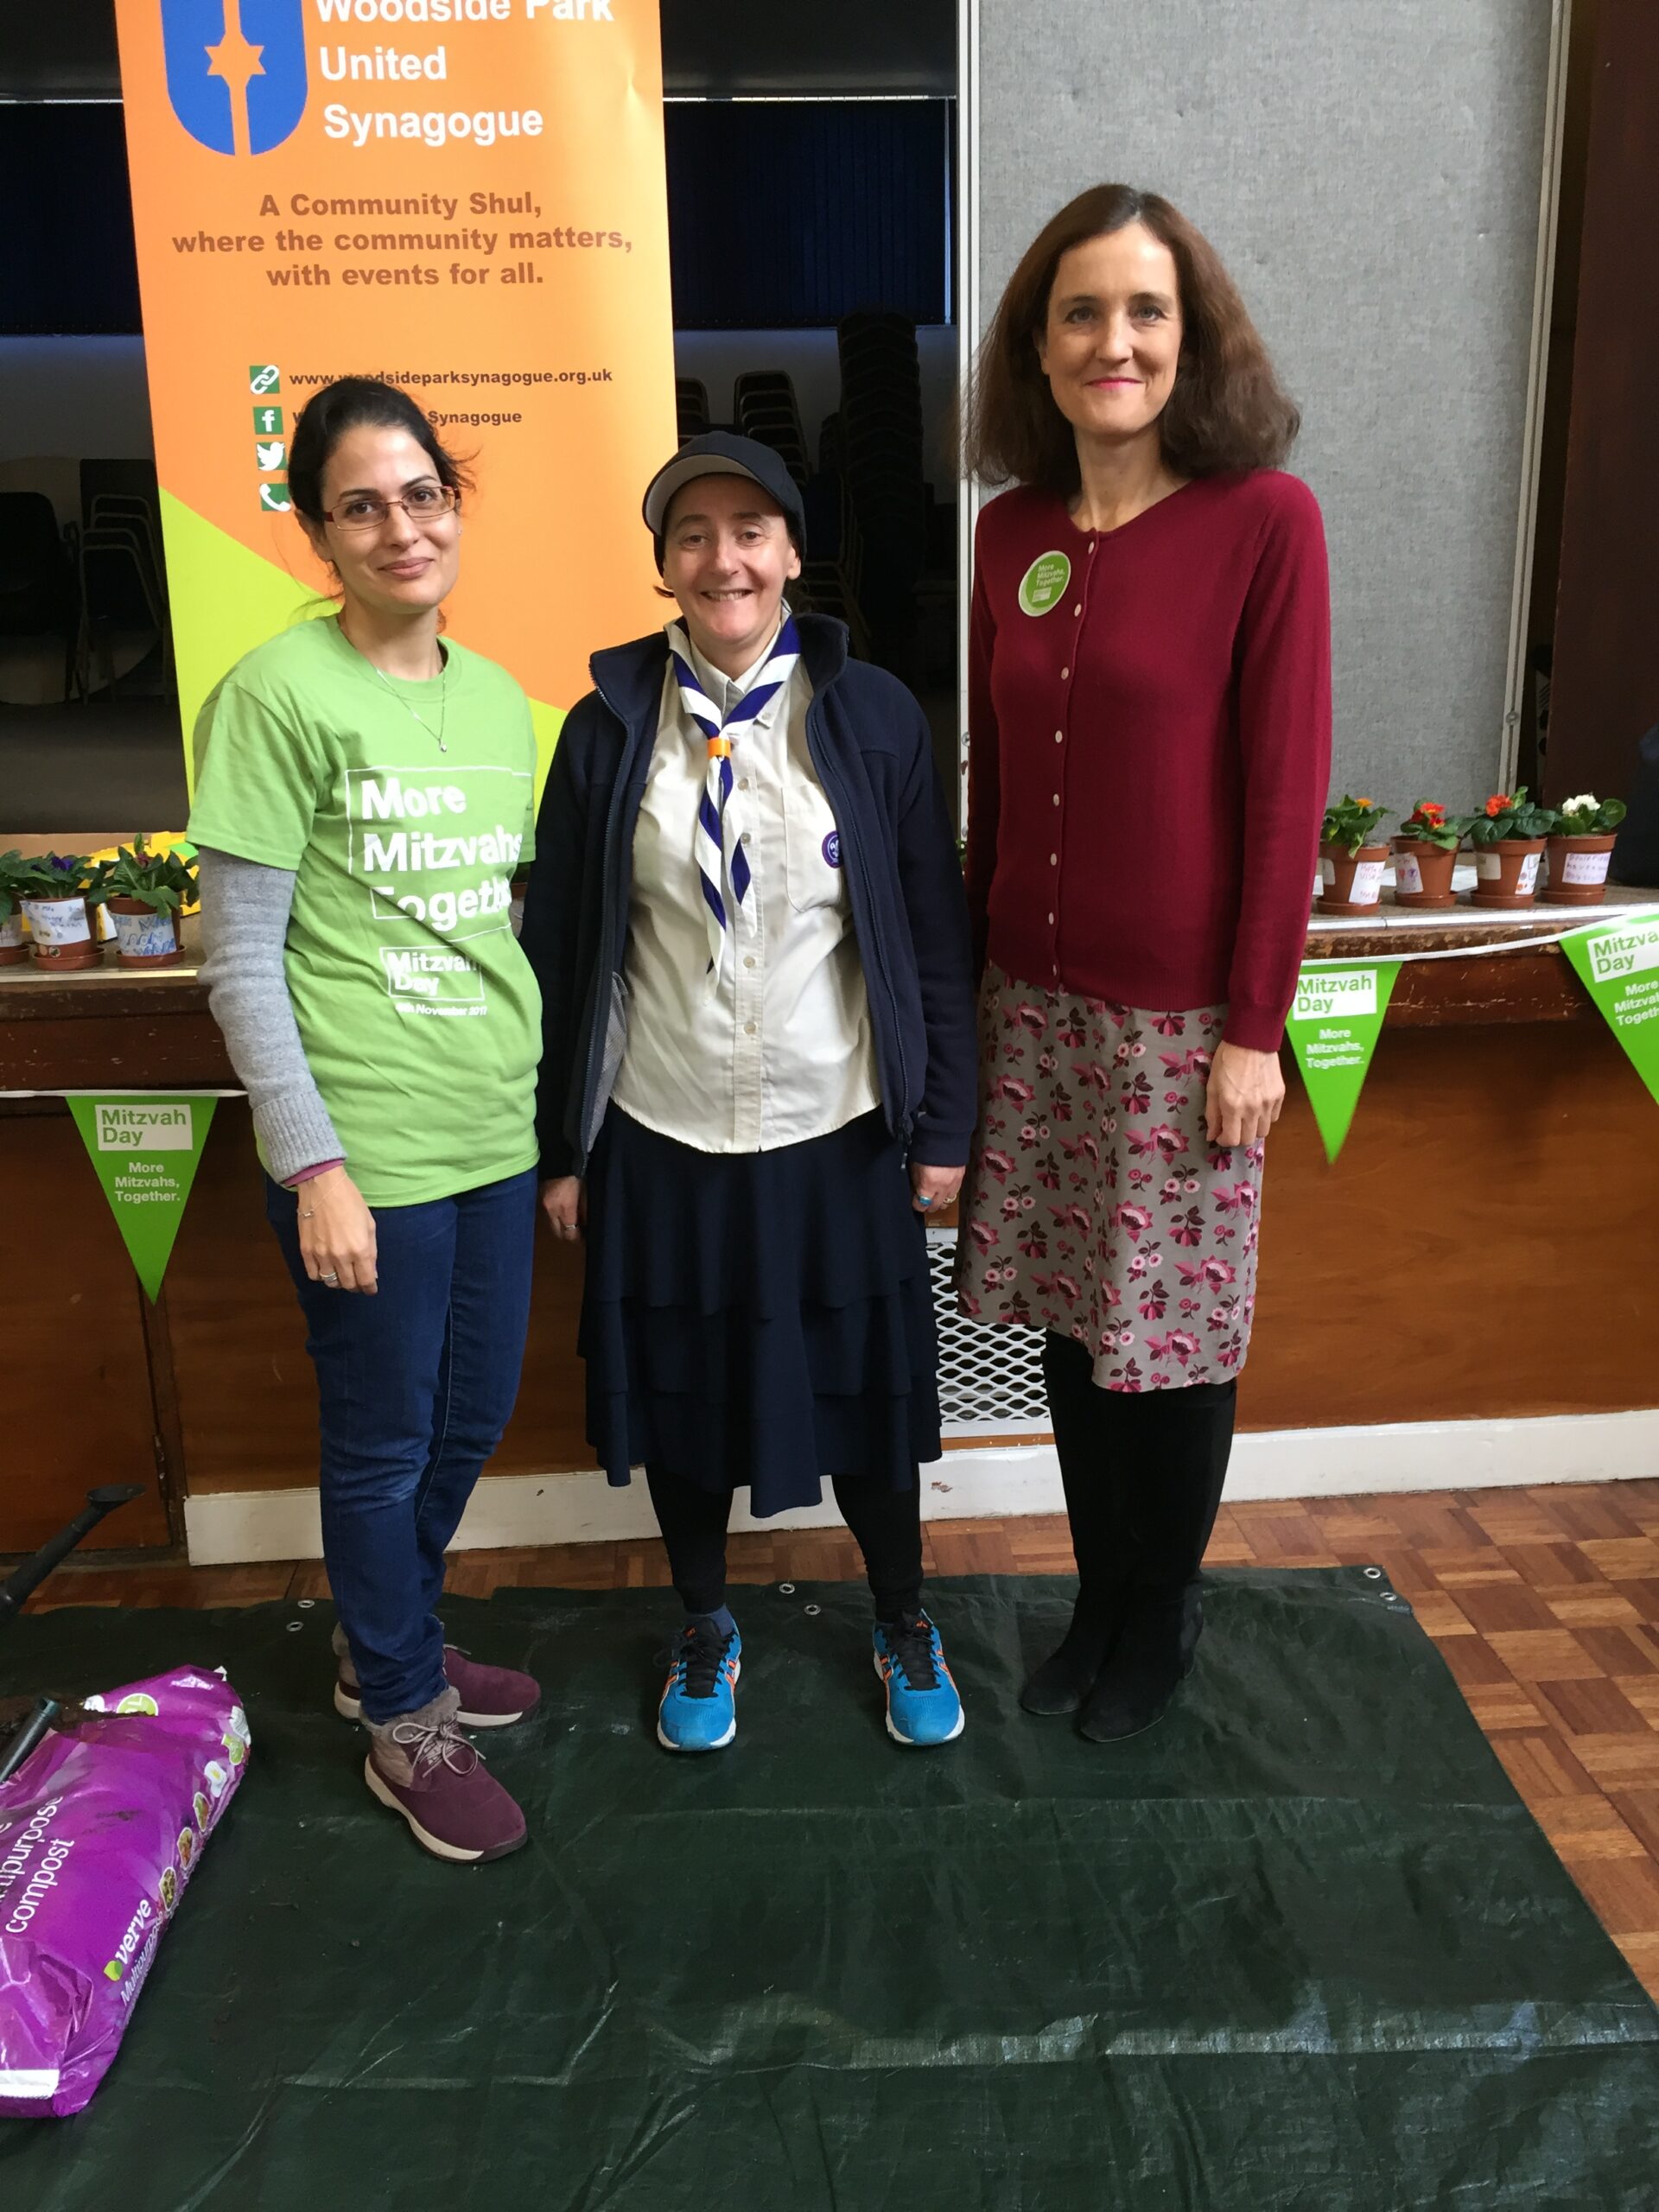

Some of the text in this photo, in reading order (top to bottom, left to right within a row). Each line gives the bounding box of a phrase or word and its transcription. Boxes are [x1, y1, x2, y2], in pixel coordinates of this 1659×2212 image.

[317, 0, 614, 22] Woodside Park
[320, 46, 448, 80] United
[323, 104, 543, 146] Synagogue
[259, 192, 543, 220] A Community Shul,
[172, 226, 632, 256] where the community matters,
[266, 261, 543, 286] with events for all.
[289, 368, 613, 387] wwwodsideparksynagogue.org.uk
[428, 410, 522, 426] Synagogue
[361, 778, 467, 819] More
[1597, 955, 1635, 975] Day
[394, 970, 439, 996] Day
[1297, 975, 1372, 995] Mitzvah
[1625, 981, 1659, 996] More
[1298, 997, 1334, 1014] Day
[1319, 1028, 1351, 1039] More
[101, 1109, 187, 1125] Mitzvah
[103, 1127, 143, 1147] Day
[129, 1162, 164, 1173] More
[115, 1176, 180, 1188] Mitzvahs,
[115, 1191, 181, 1204] Together.
[5, 1839, 75, 1933] compost
[115, 1899, 151, 1965] verve
